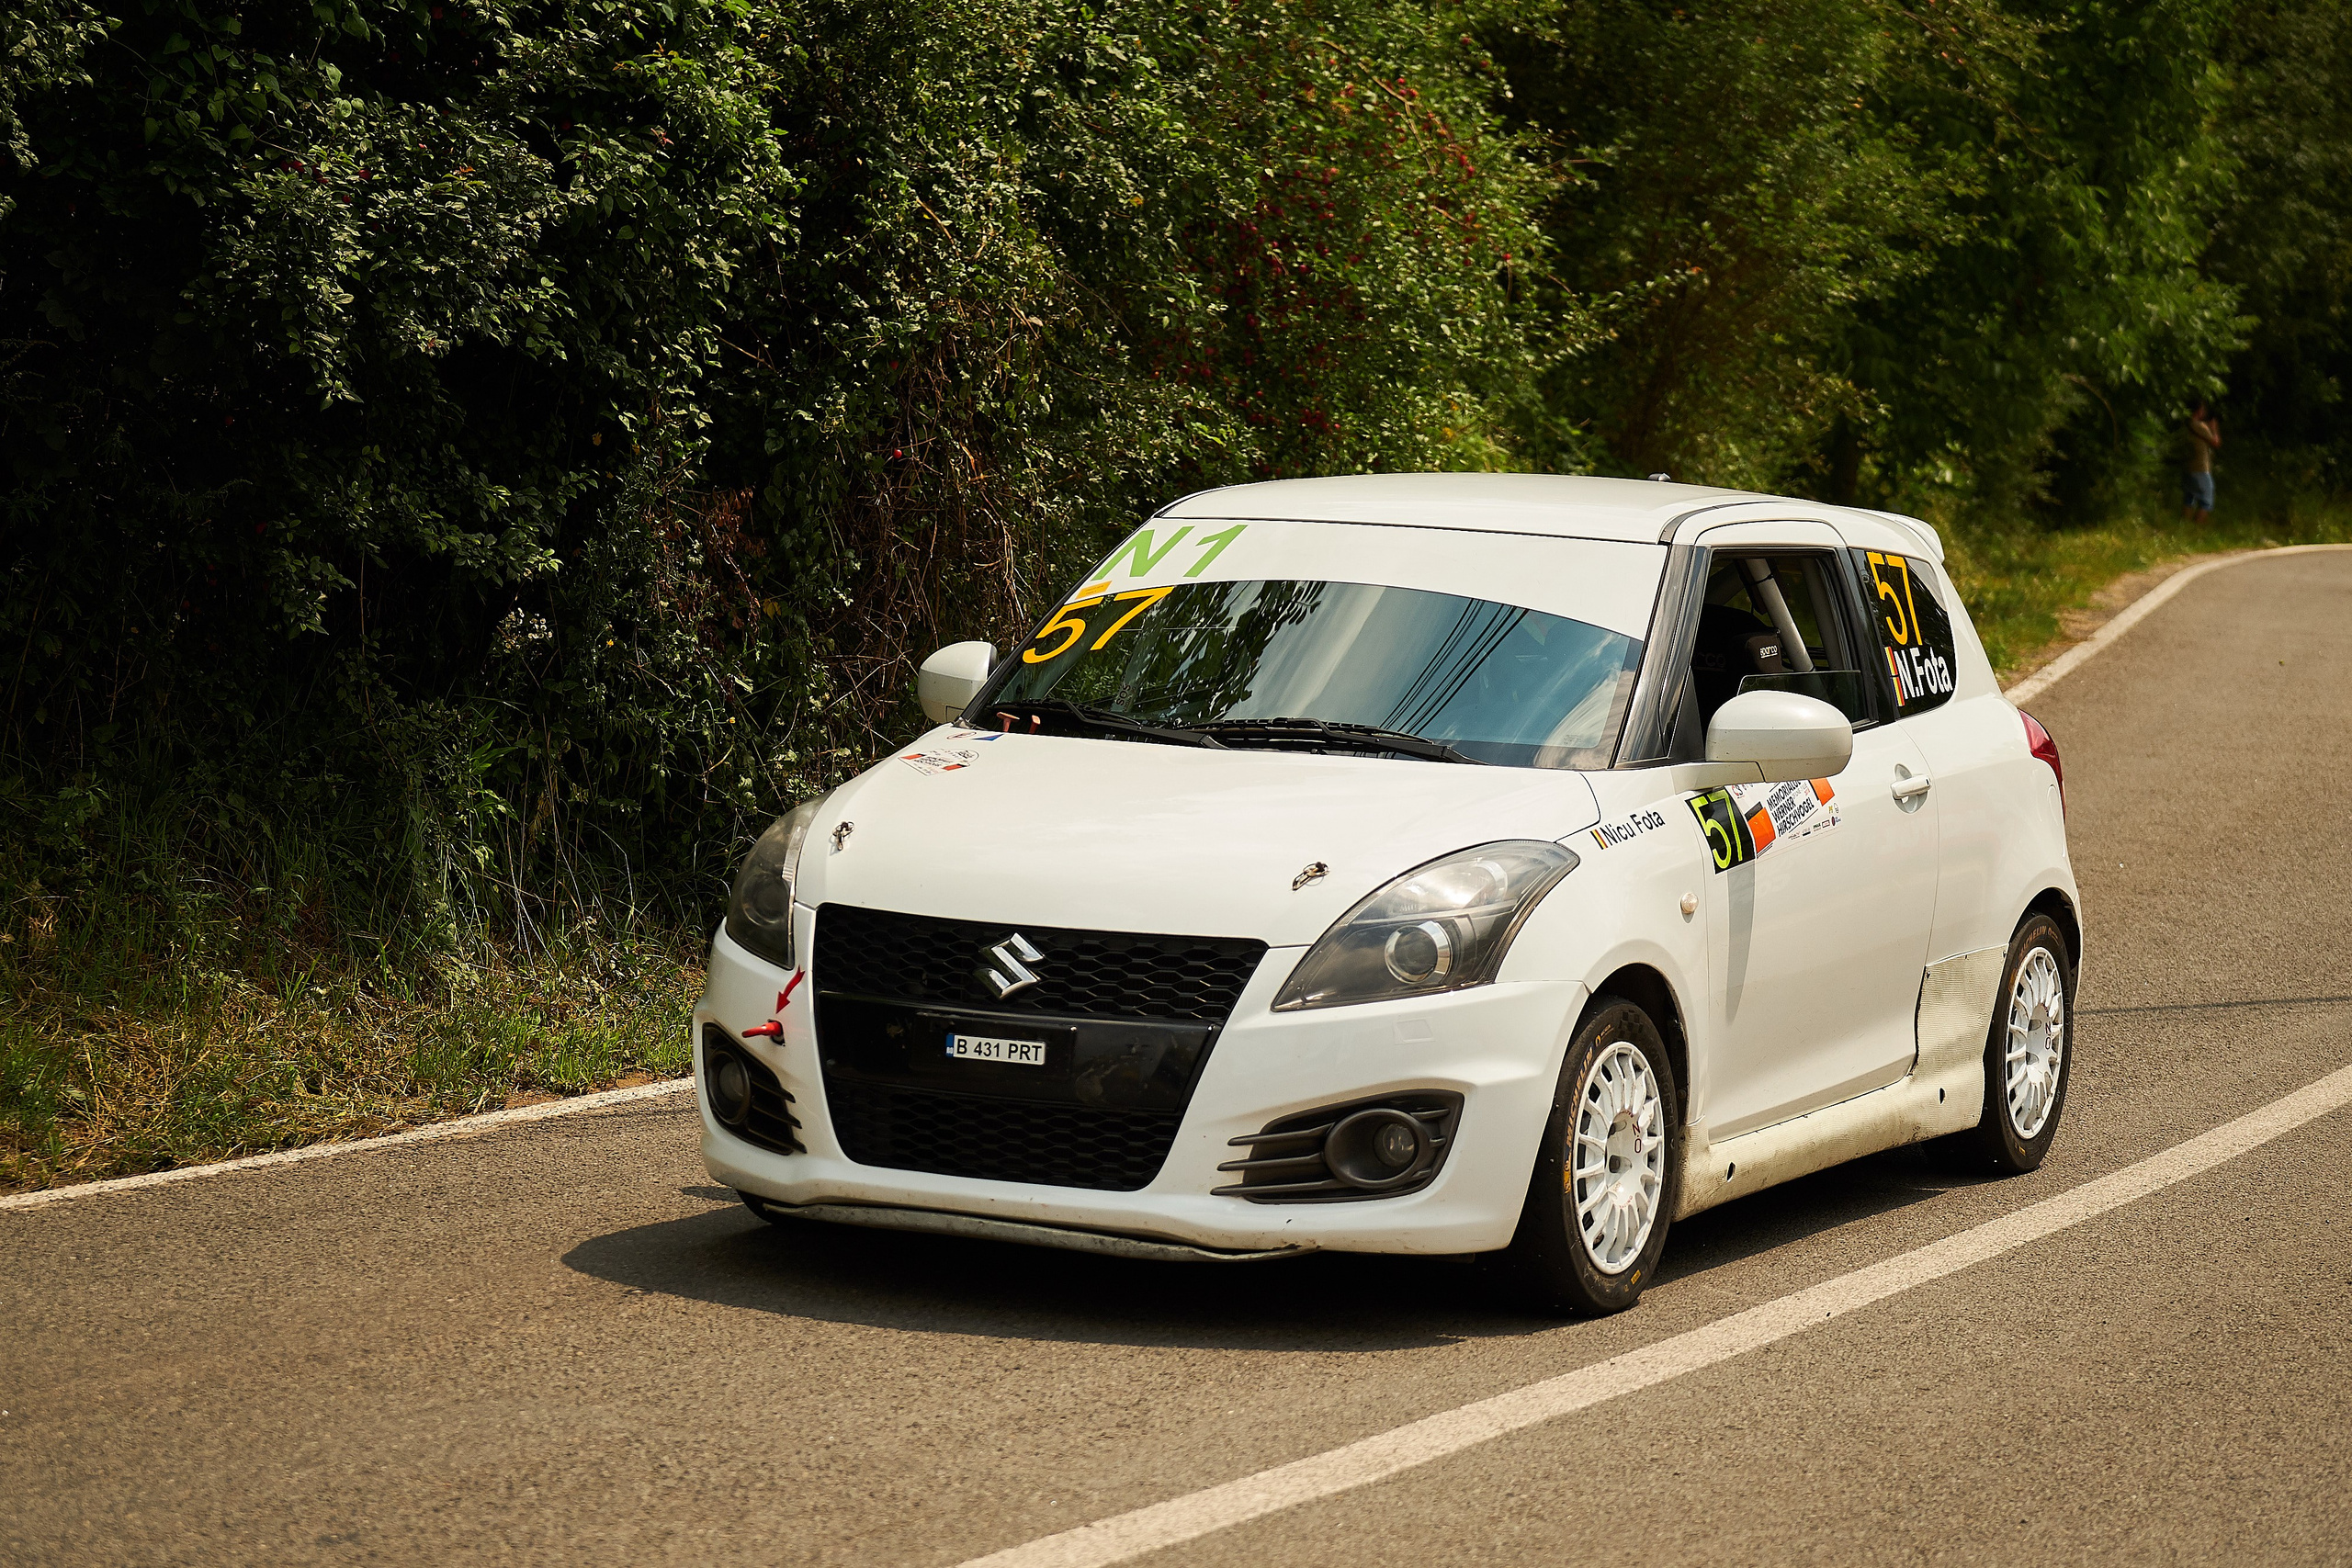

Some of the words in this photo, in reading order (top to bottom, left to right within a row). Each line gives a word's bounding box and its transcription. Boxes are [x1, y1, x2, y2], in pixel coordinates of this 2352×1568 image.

[1091, 525, 1248, 581] N1
[1022, 586, 1175, 664] 57
[1866, 551, 1923, 645] 57
[1894, 647, 1953, 700] N.Fota
[1600, 823, 1636, 846] Nicu
[1629, 809, 1666, 833] Fota
[1690, 789, 1743, 869] 57
[1771, 796, 1797, 824] WERNER
[1776, 796, 1815, 838] HIRSCHVOGEL
[956, 1038, 967, 1055] B
[973, 1041, 1000, 1058] 431
[1008, 1043, 1042, 1062] PRT
[1566, 1046, 1593, 1147] MICHELIN
